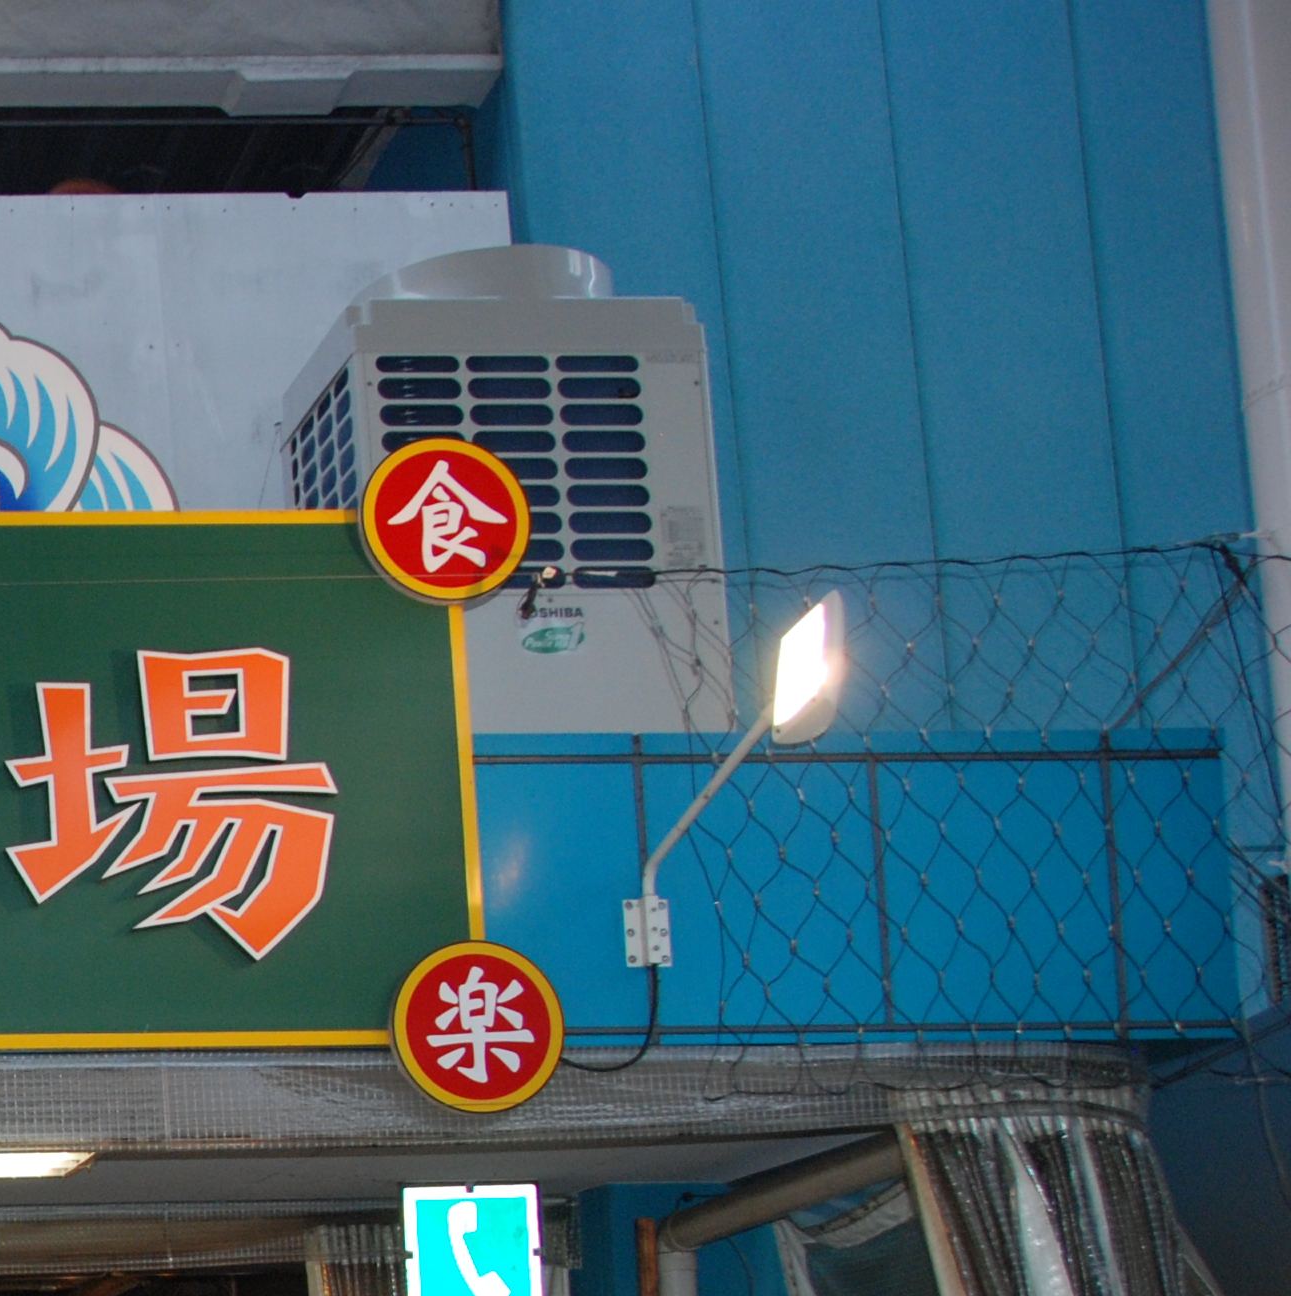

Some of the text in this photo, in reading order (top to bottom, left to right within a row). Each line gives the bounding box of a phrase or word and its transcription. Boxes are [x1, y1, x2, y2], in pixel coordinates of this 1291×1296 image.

[387, 461, 507, 573] 食
[525, 607, 583, 618] SHIBA
[434, 965, 535, 1083] 楽
